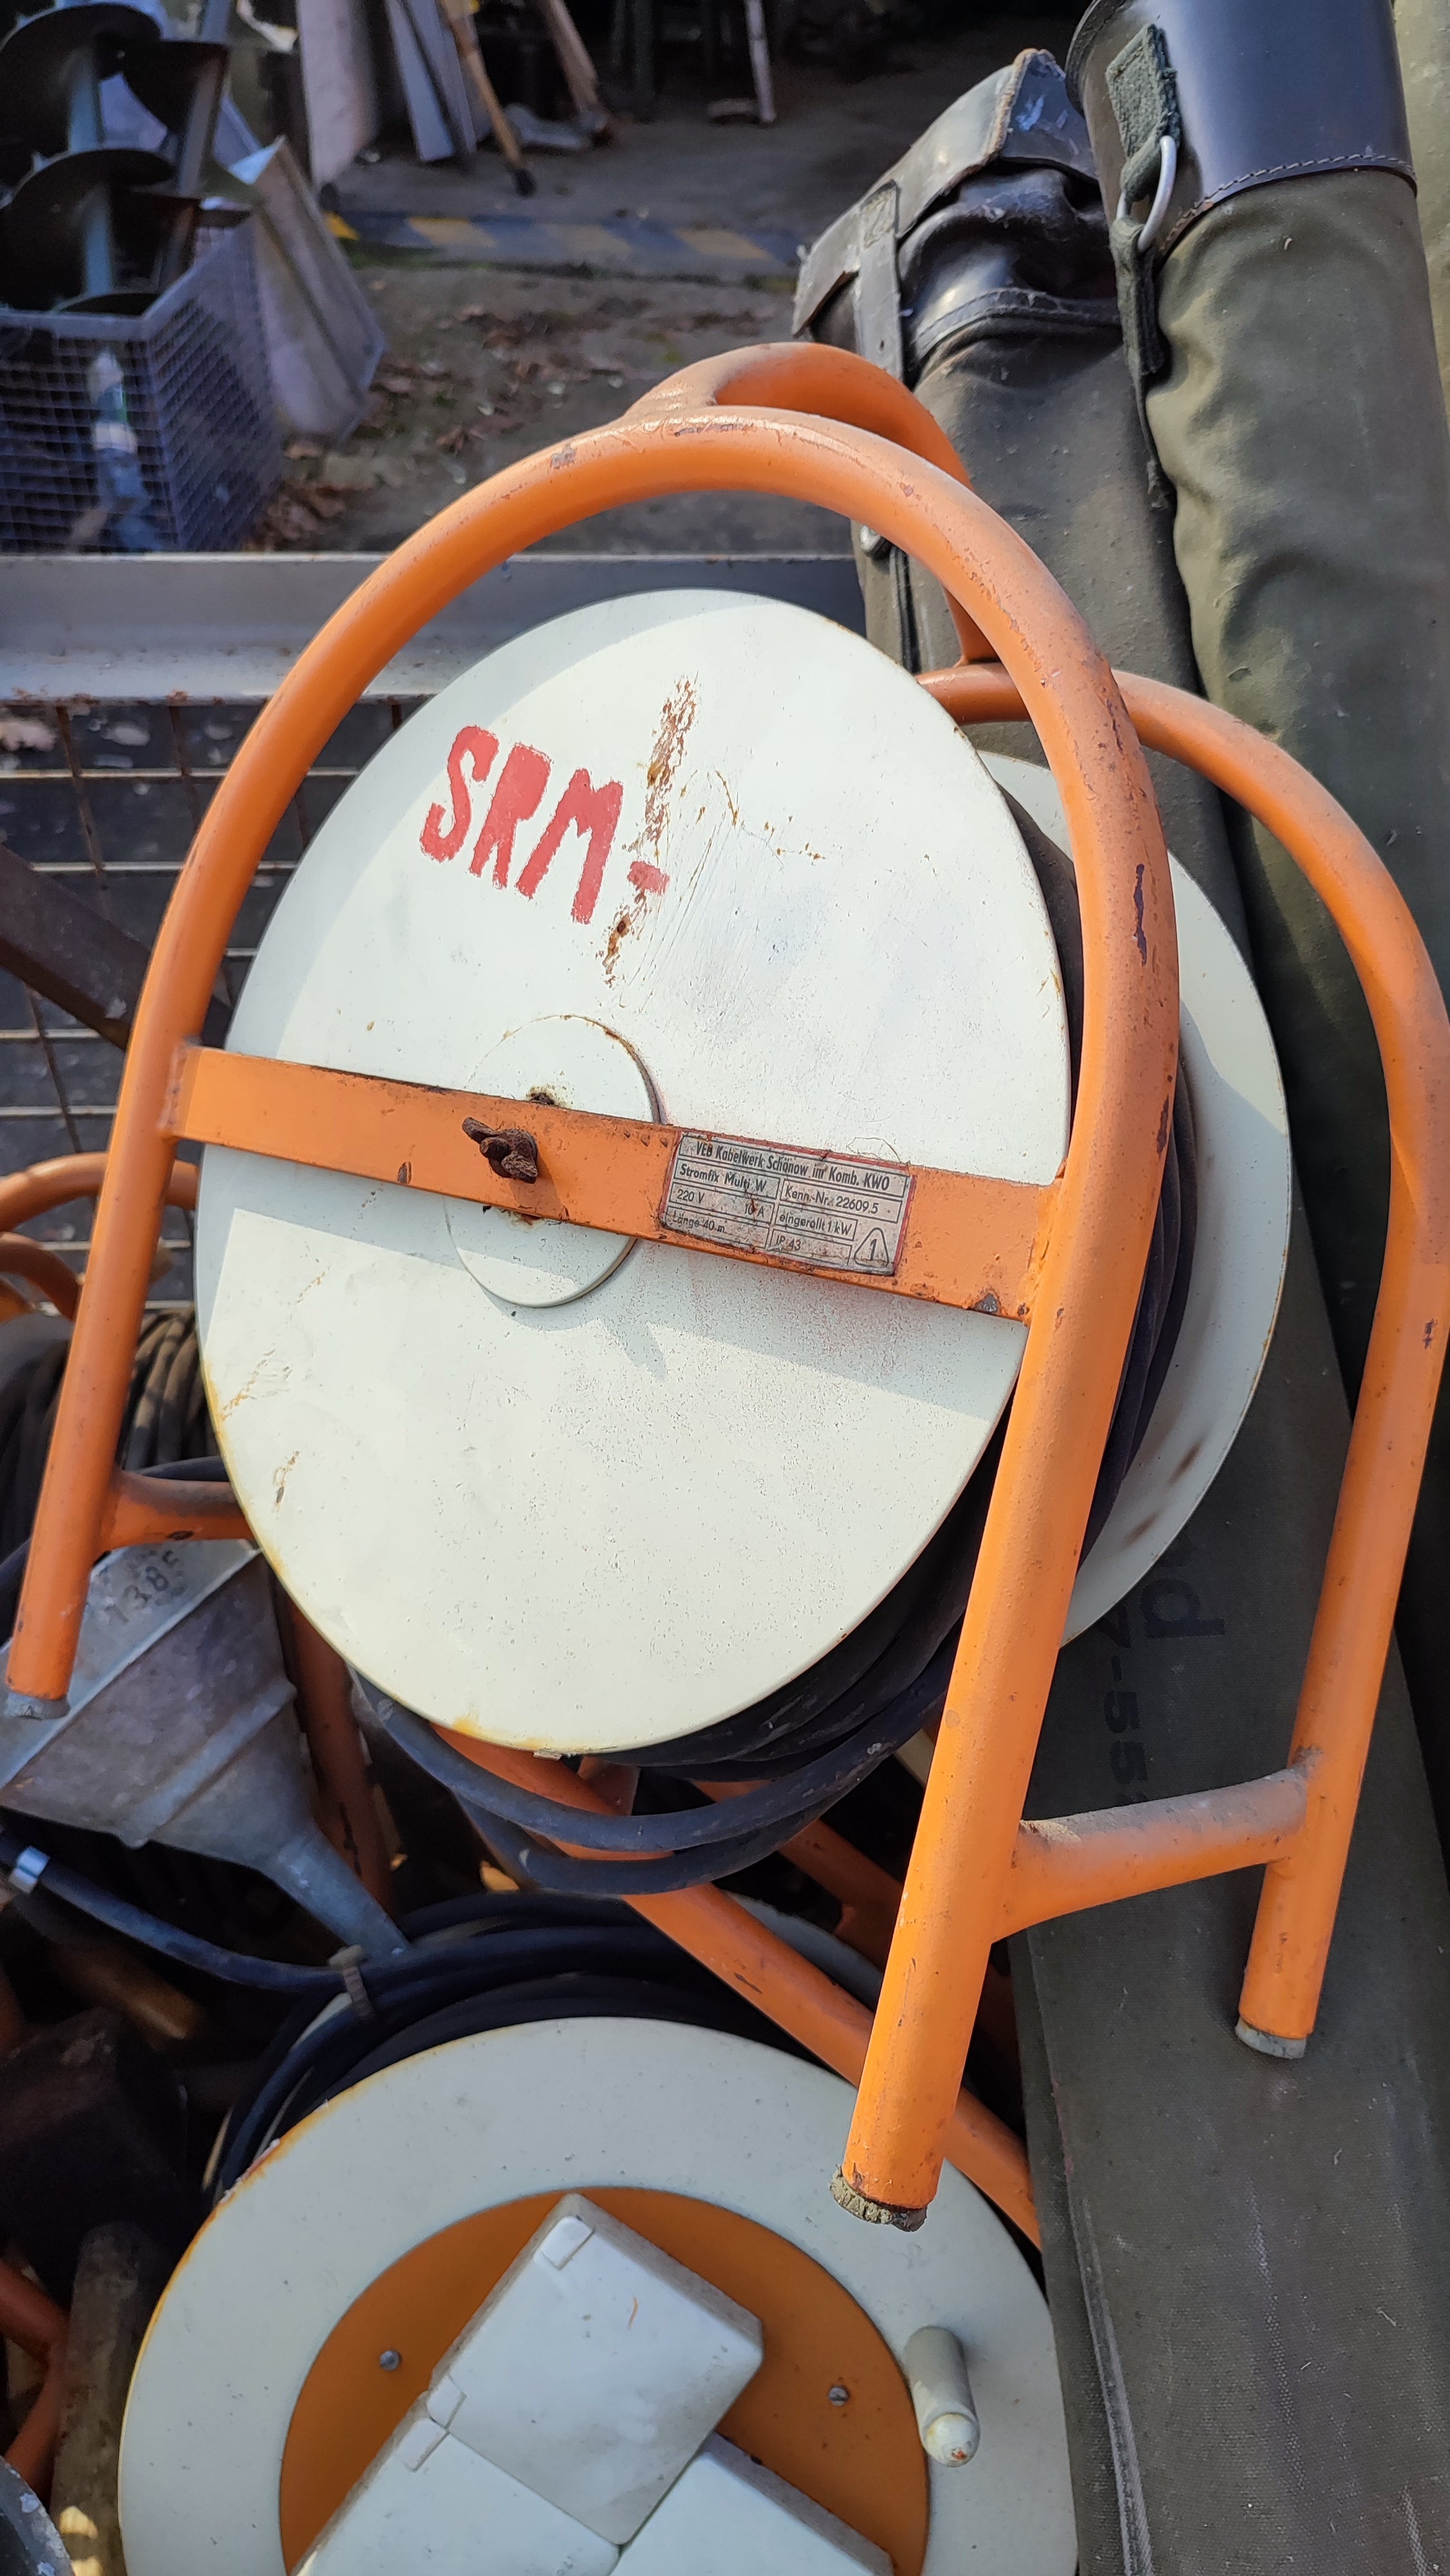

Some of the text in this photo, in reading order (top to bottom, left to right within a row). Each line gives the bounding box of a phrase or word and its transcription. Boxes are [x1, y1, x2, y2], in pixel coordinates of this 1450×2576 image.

[680, 1163, 767, 1192] Stromfix Multi W
[696, 1141, 890, 1191] VEB Kabelwerk Schönow im Komb. KWO
[676, 1188, 705, 1204] 220 V
[836, 1195, 880, 1215] 22609.5
[672, 1209, 726, 1234] Länge 40 m
[744, 1202, 764, 1218] 10 A
[779, 1212, 852, 1236] eingerollt 1 kW
[776, 1234, 802, 1251] IP 43
[870, 1238, 878, 1262] 1
